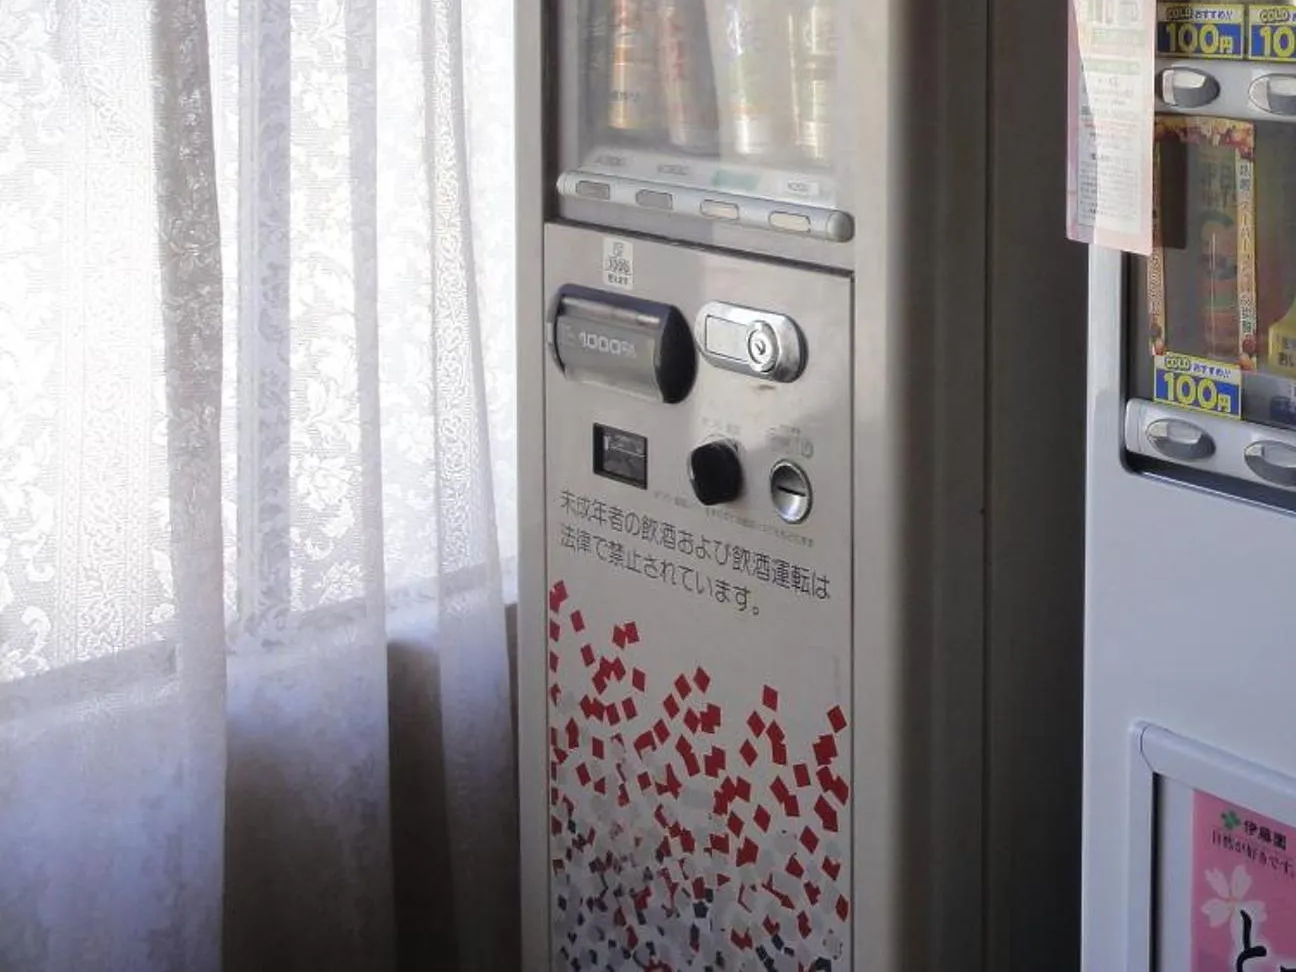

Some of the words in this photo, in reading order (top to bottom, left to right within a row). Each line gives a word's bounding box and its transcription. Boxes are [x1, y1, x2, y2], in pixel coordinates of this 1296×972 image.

[1166, 22, 1234, 56] 100円
[1164, 372, 1232, 413] 100円
[561, 489, 830, 600] 未成年者の飲酒および飲酒運転は
[561, 522, 760, 616] 法律で禁止されています。
[1243, 819, 1287, 851] 伊藤園
